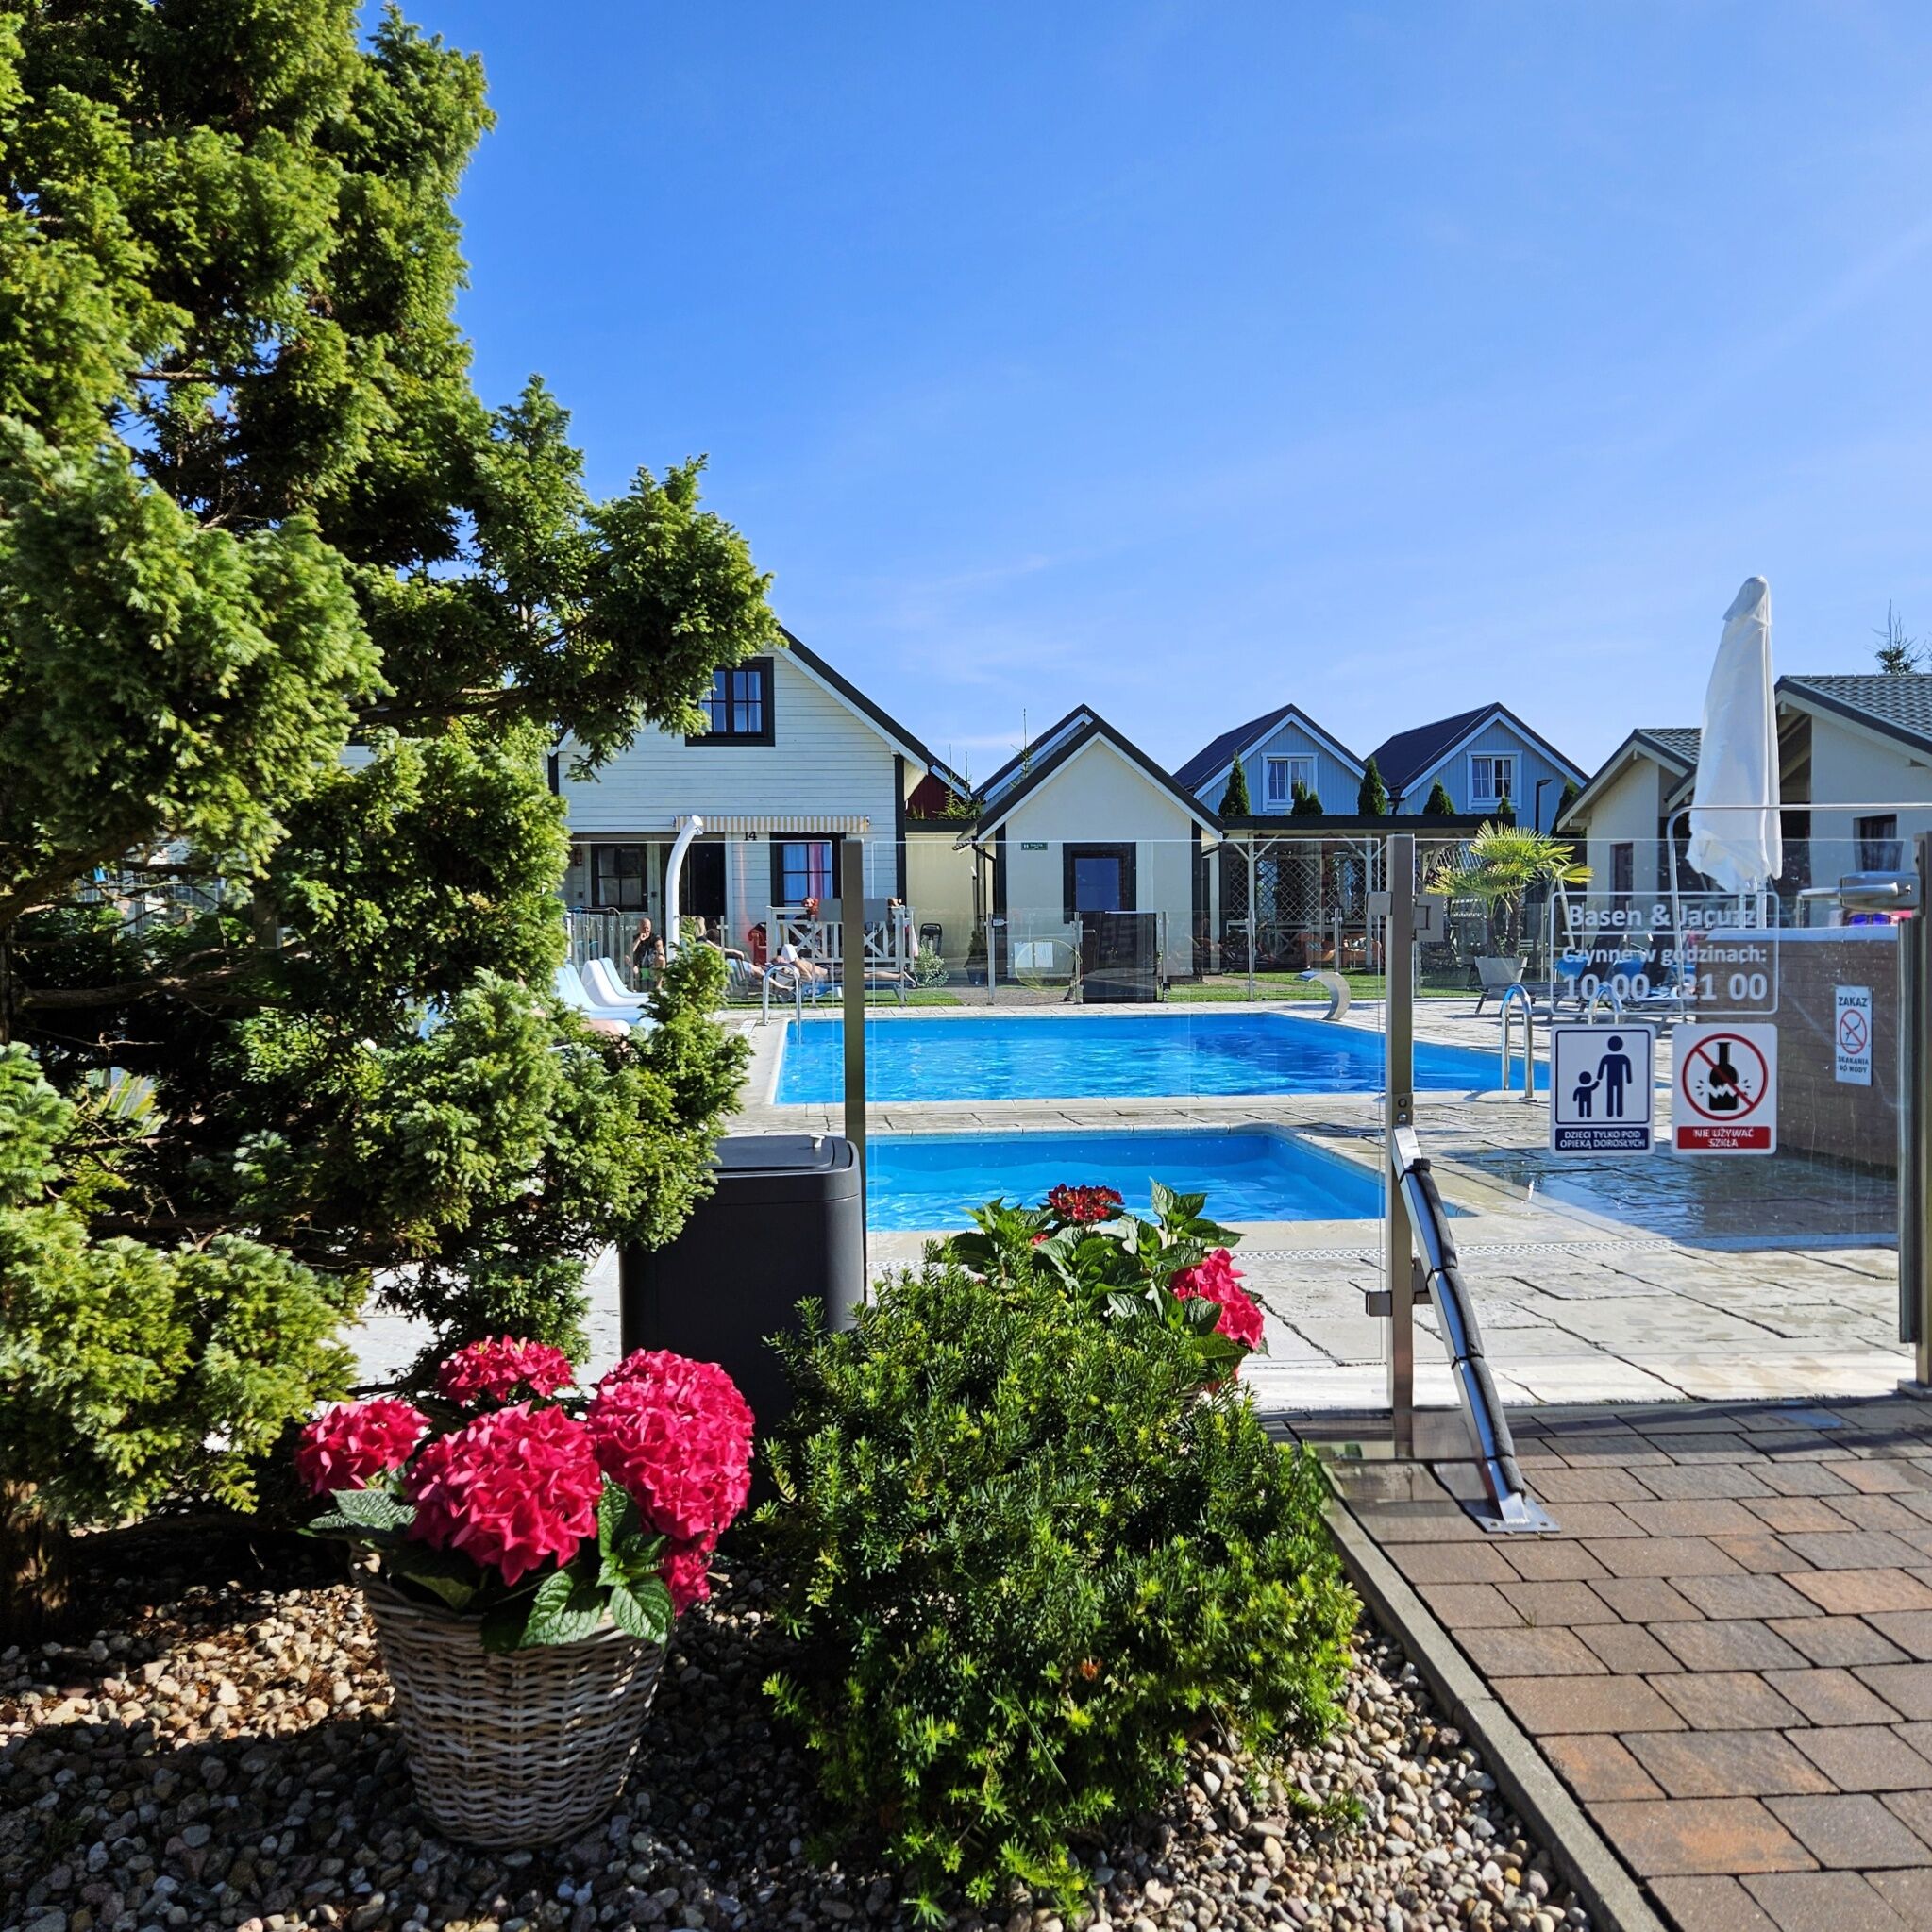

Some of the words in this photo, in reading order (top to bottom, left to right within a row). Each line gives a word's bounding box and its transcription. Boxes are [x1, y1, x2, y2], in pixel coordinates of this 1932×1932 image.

[1569, 905, 1642, 927] Basen
[1650, 904, 1671, 927] &
[1678, 904, 1763, 927] Jacuzz
[1562, 946, 1633, 967] Czynne
[1638, 949, 1657, 963] w
[1659, 944, 1768, 966] godzinach:
[1838, 996, 1869, 1008] ZAKAZ
[1564, 1131, 1592, 1139] DZIECI
[1592, 1130, 1621, 1139] TYLKO
[1621, 1130, 1641, 1139] POD
[1692, 1128, 1710, 1138] NIE
[1559, 1139, 1592, 1150] OPIEKĄ
